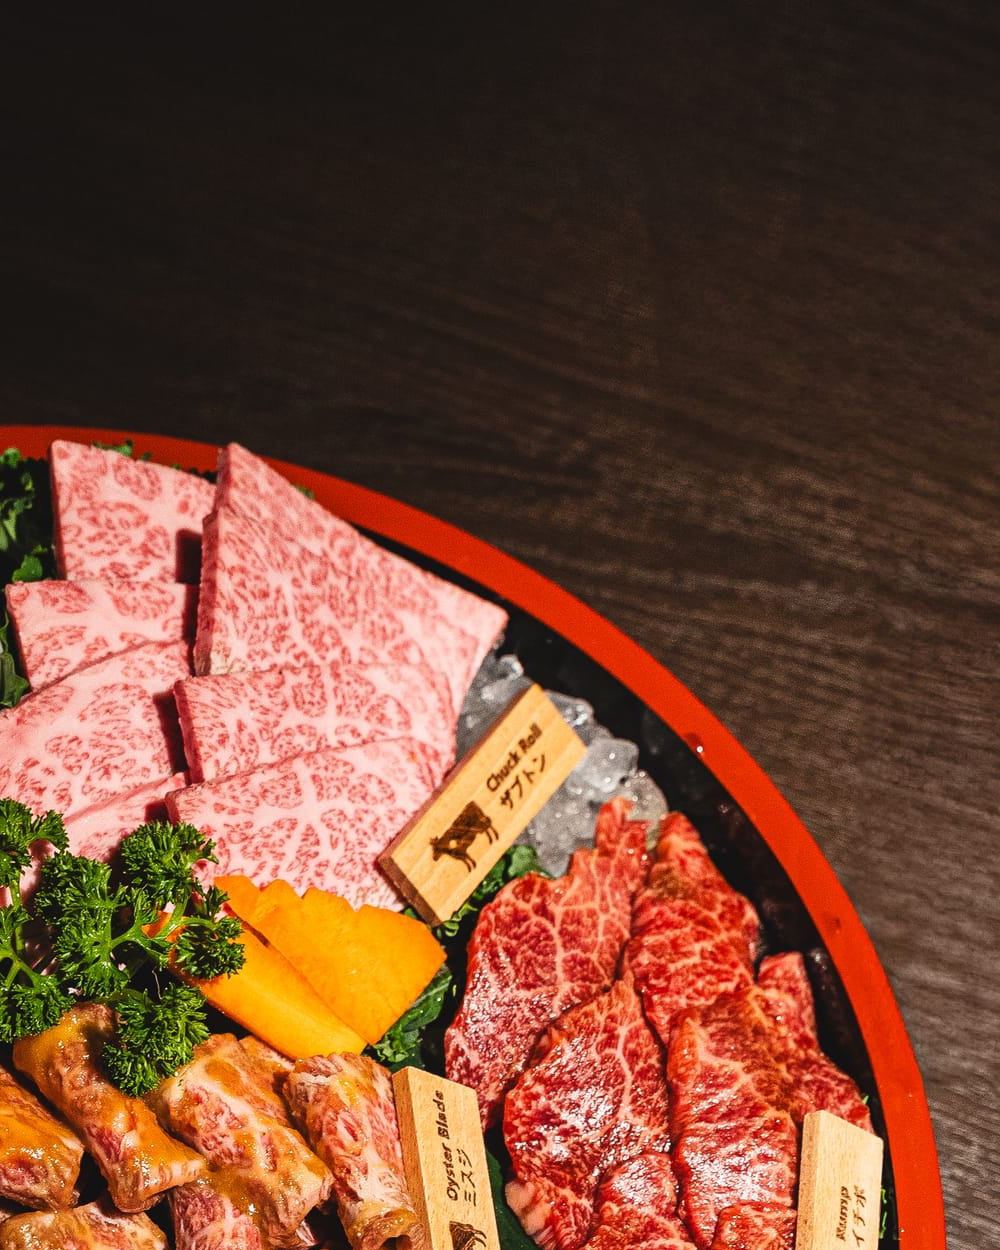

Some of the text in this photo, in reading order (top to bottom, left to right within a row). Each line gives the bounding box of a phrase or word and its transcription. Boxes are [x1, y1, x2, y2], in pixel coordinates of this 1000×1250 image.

[487, 722, 543, 792] Chuck Roll
[432, 1090, 460, 1201] Oyster Blade
[456, 1148, 476, 1207] ミスジ
[836, 1186, 852, 1242] Rump
